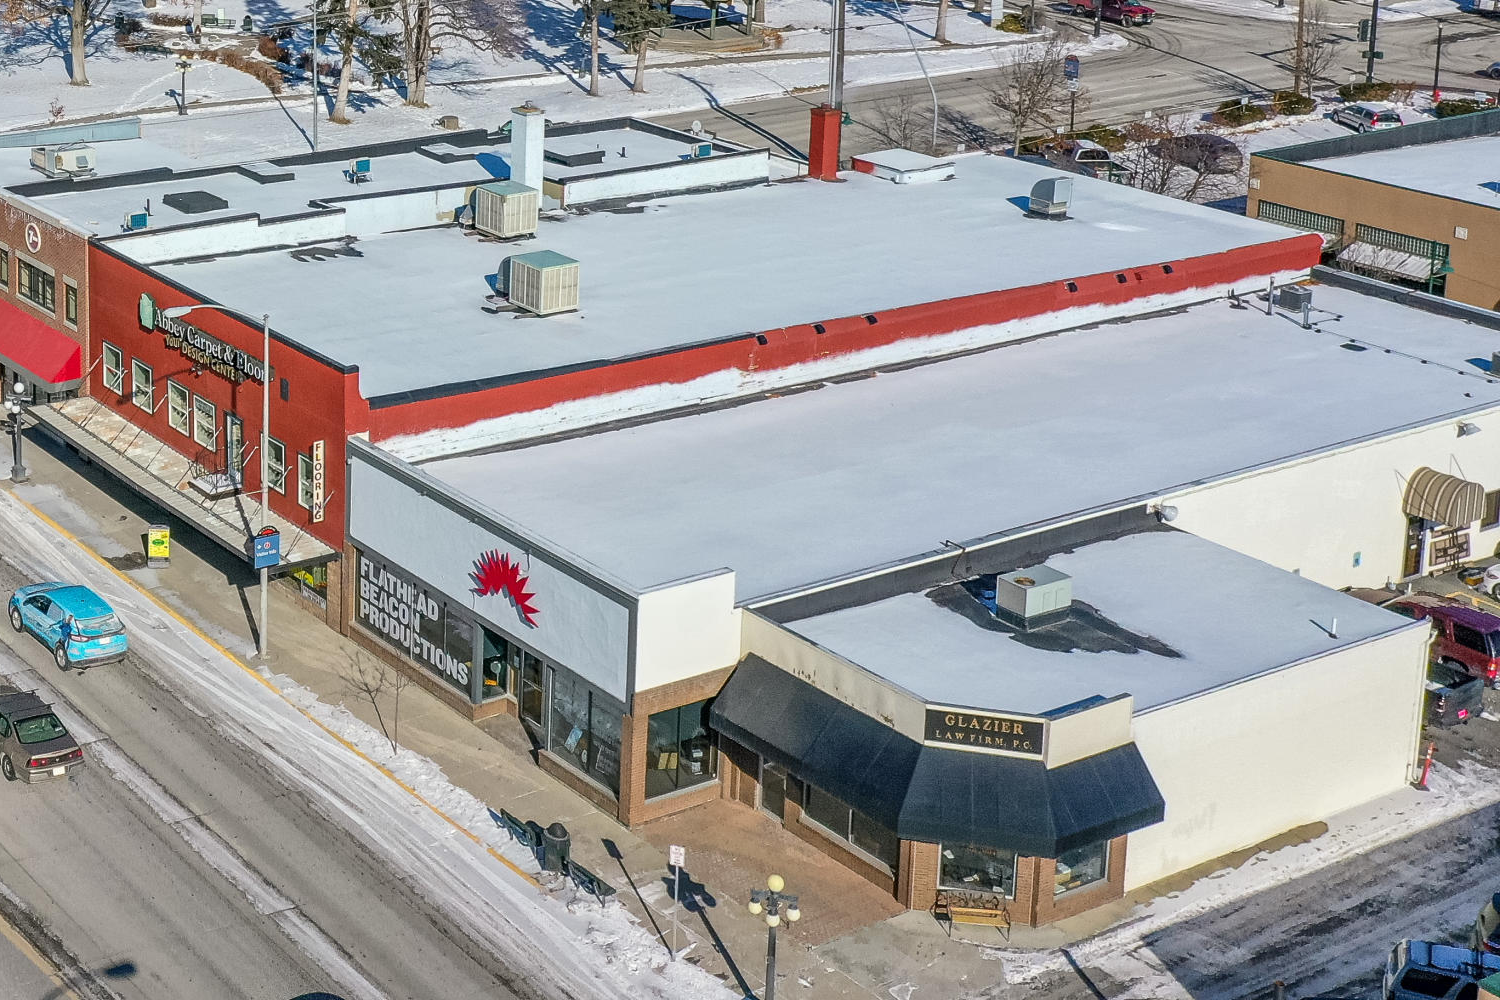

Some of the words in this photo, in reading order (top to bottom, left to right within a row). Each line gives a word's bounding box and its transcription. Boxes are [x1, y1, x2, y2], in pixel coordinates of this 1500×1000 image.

[155, 307, 185, 341] Abbey
[187, 326, 222, 359] Carpet
[223, 345, 235, 365] &
[182, 341, 210, 367] DESIGN
[314, 443, 322, 519] FLOORING
[360, 556, 439, 621] FLATHEAD
[360, 577, 420, 633] BEACON
[360, 598, 468, 685] PRODUCTIONS
[936, 730, 964, 740] LAW
[944, 714, 1024, 735] GLAZIER
